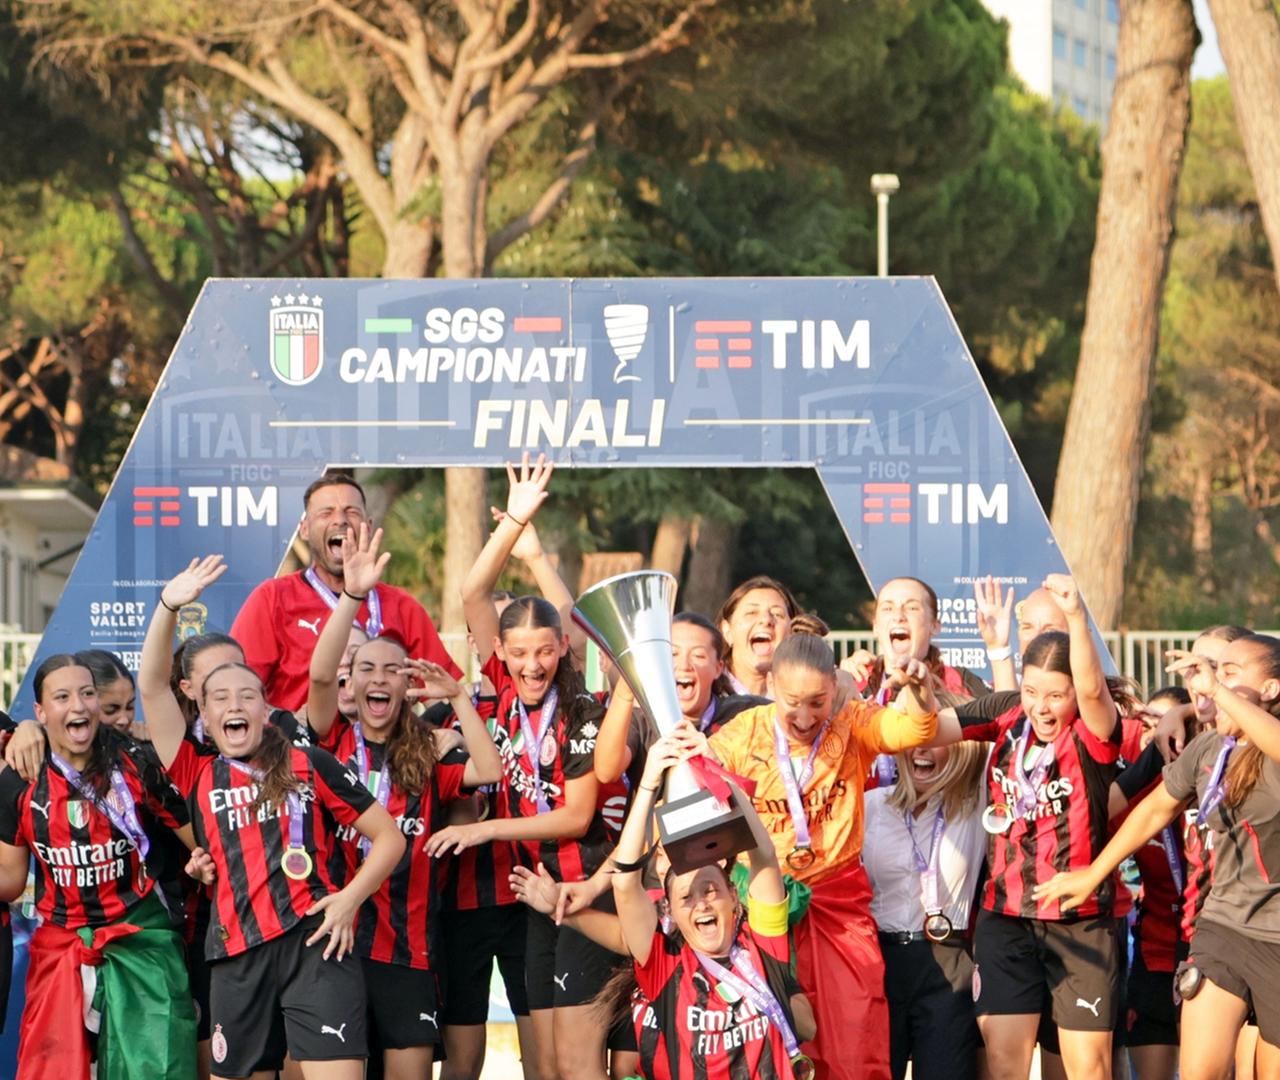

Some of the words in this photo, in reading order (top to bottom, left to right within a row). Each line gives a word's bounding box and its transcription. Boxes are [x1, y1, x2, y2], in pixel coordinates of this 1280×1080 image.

[274, 313, 319, 331] ITALIA
[423, 307, 506, 344] SGS
[761, 319, 871, 370] TIM
[338, 347, 588, 384] CAMPIONATI
[178, 412, 322, 458] ITALIA
[472, 398, 666, 449] FINALI
[816, 409, 962, 457] ITALIA
[230, 463, 272, 482] FIGC
[868, 460, 911, 479] FIGC
[188, 486, 278, 527] TIM
[918, 483, 1009, 524] TIM
[90, 601, 146, 615] SPORT
[937, 598, 977, 612] POR
[937, 611, 977, 624] ALLE
[90, 615, 146, 627] VALLEY
[569, 738, 596, 755] MS
[32, 837, 137, 868] Emirates
[52, 866, 72, 889] FLY
[76, 857, 125, 888] BETTER
[698, 1033, 720, 1056] FLY
